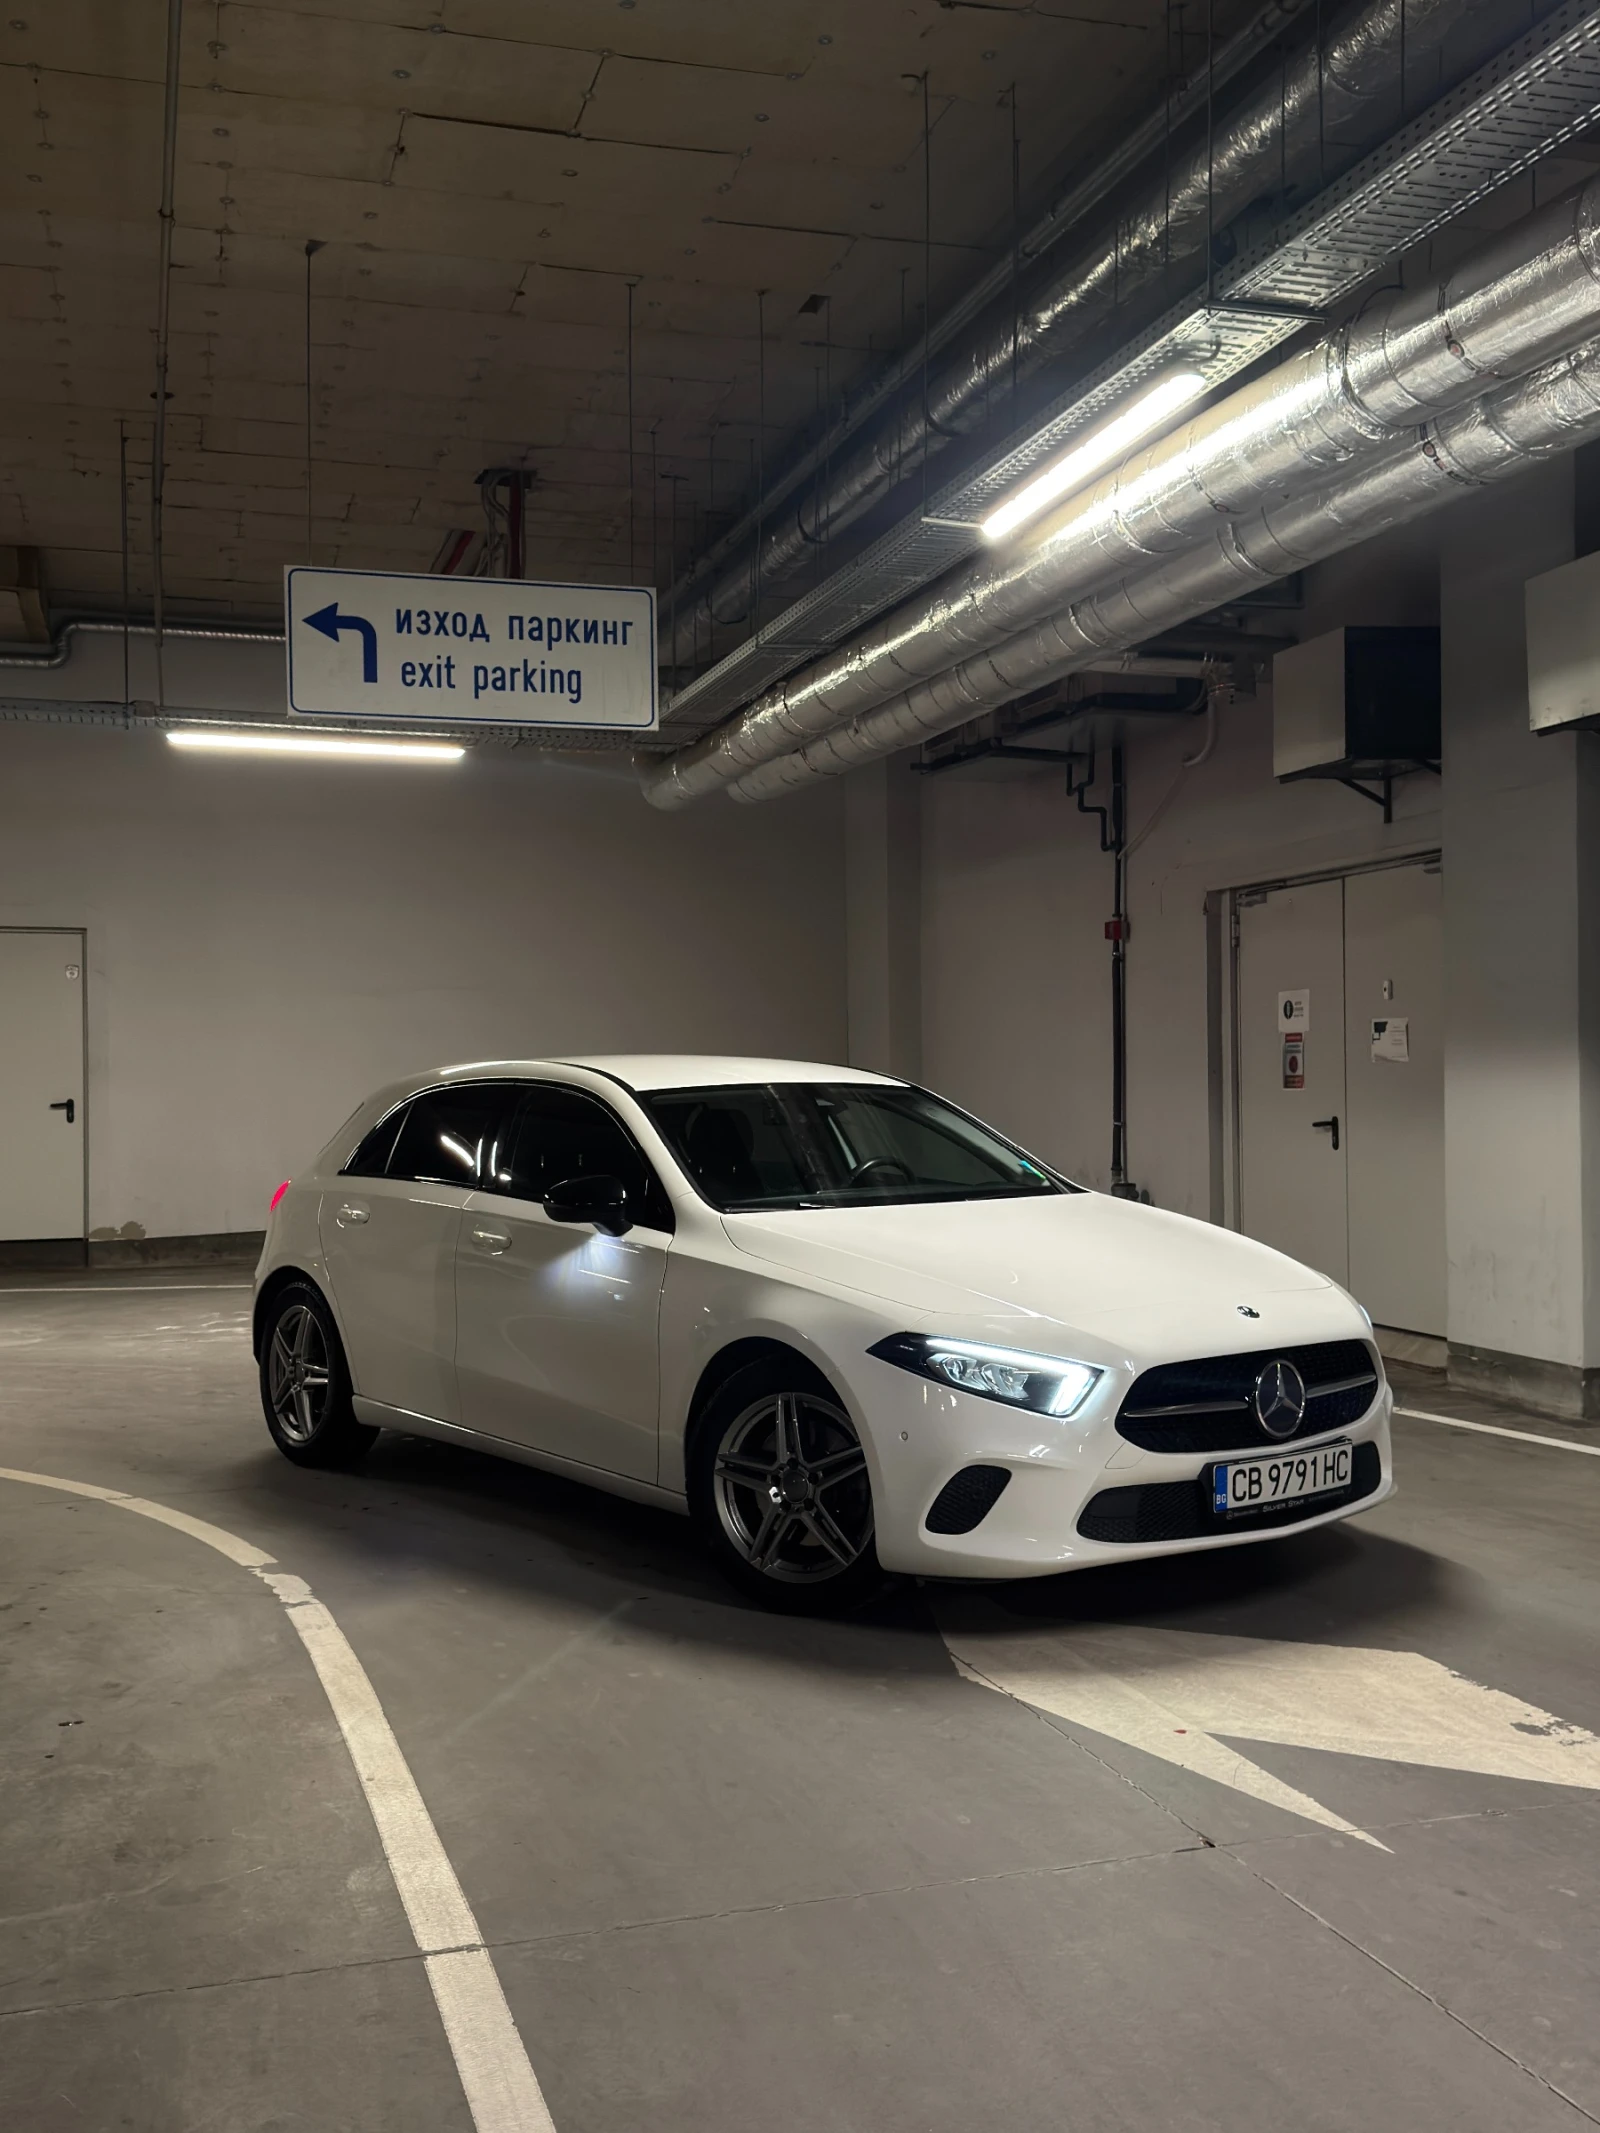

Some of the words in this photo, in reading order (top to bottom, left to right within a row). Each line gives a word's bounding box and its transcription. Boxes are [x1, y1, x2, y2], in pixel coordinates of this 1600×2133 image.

[396, 608, 490, 643] изход
[508, 615, 633, 651] паркинг
[401, 655, 456, 689] exit
[473, 659, 582, 704] parking
[1216, 1493, 1227, 1505] BG
[1232, 1467, 1263, 1502] CB
[1268, 1456, 1317, 1496] 9791
[1323, 1450, 1348, 1485] HC
